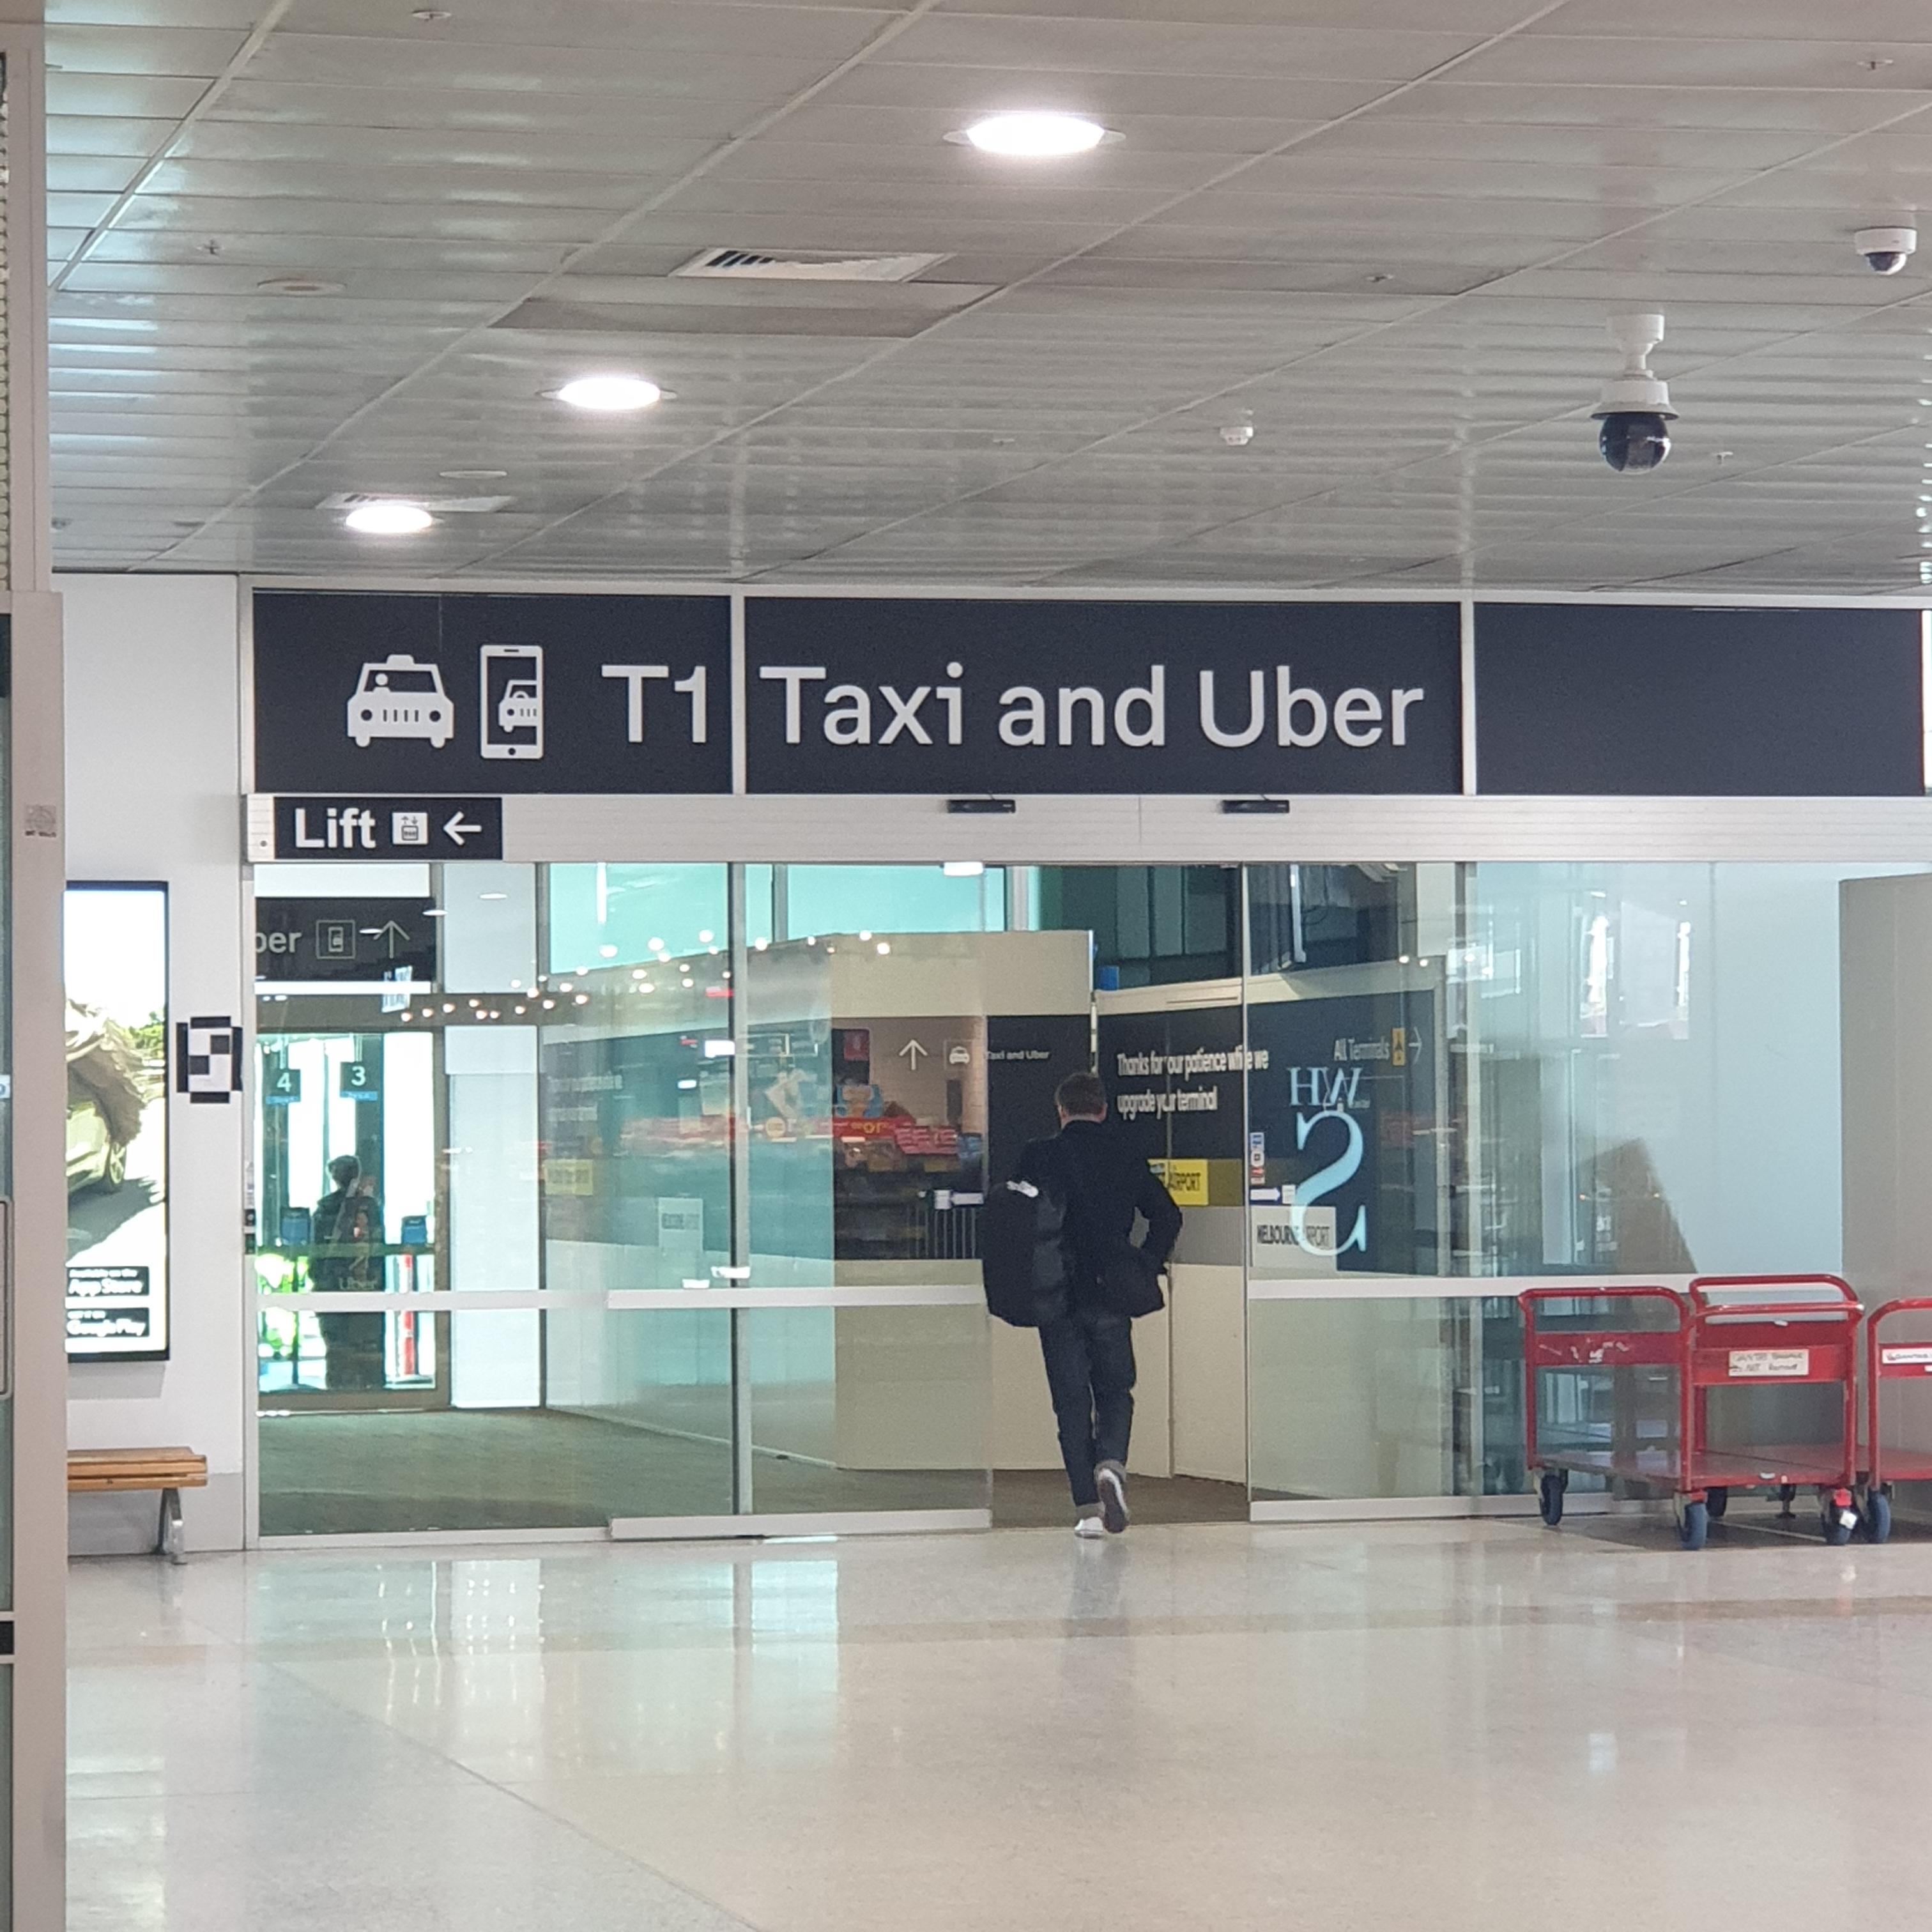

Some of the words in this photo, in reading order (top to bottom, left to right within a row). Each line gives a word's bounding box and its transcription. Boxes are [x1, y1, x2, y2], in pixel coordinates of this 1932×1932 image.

[601, 664, 707, 744] T1
[760, 661, 963, 746] Taxi
[998, 664, 1166, 747] and
[1199, 664, 1424, 748] Uber
[295, 808, 377, 850] Lift
[1006, 1050, 1024, 1060] and
[1025, 1050, 1050, 1059] Uber
[1117, 1052, 1149, 1075] Thanks
[1150, 1050, 1163, 1075] for
[1184, 1046, 1227, 1081] patience
[1227, 1044, 1253, 1071] whie
[1254, 1049, 1269, 1070] we
[277, 1072, 291, 1092] 4
[351, 1066, 366, 1086] 3
[1117, 1088, 1156, 1120] upgrade
[1177, 1086, 1218, 1112] terminal
